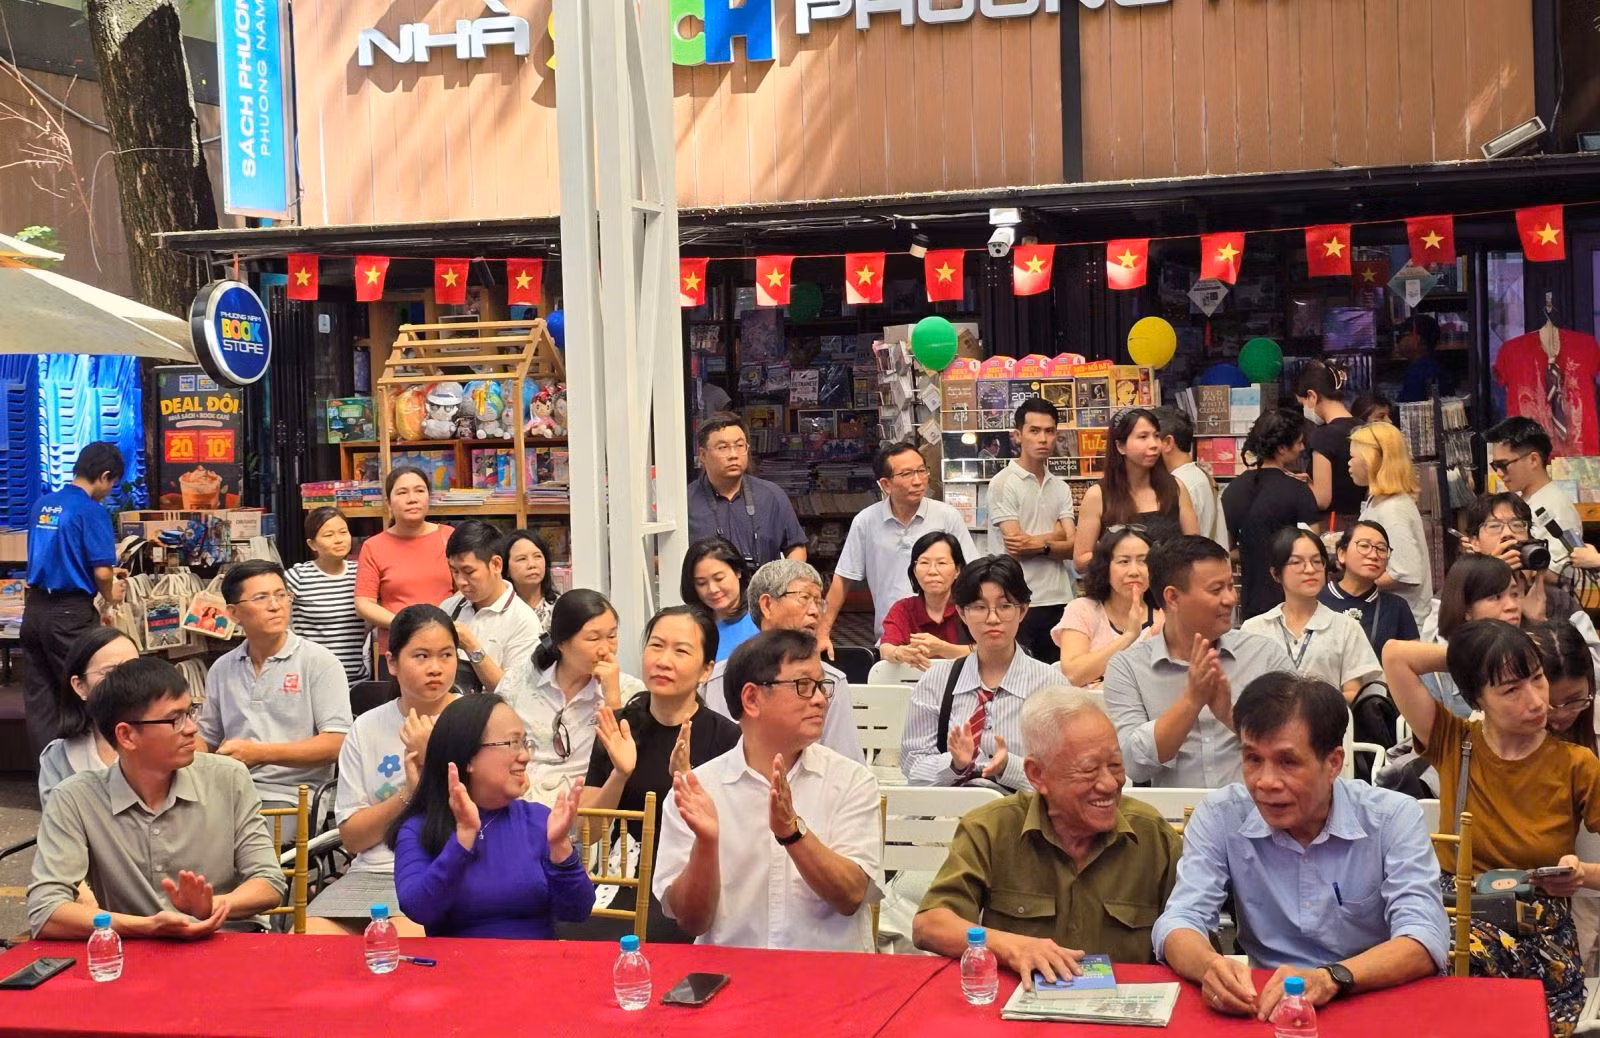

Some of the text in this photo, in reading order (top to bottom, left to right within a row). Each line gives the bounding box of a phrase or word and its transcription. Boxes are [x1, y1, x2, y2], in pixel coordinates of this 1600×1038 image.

[256, 59, 271, 157] PHUONG
[221, 318, 262, 342] BOOK
[223, 339, 264, 355] STORE
[160, 393, 239, 415] DEAL ĐÔI
